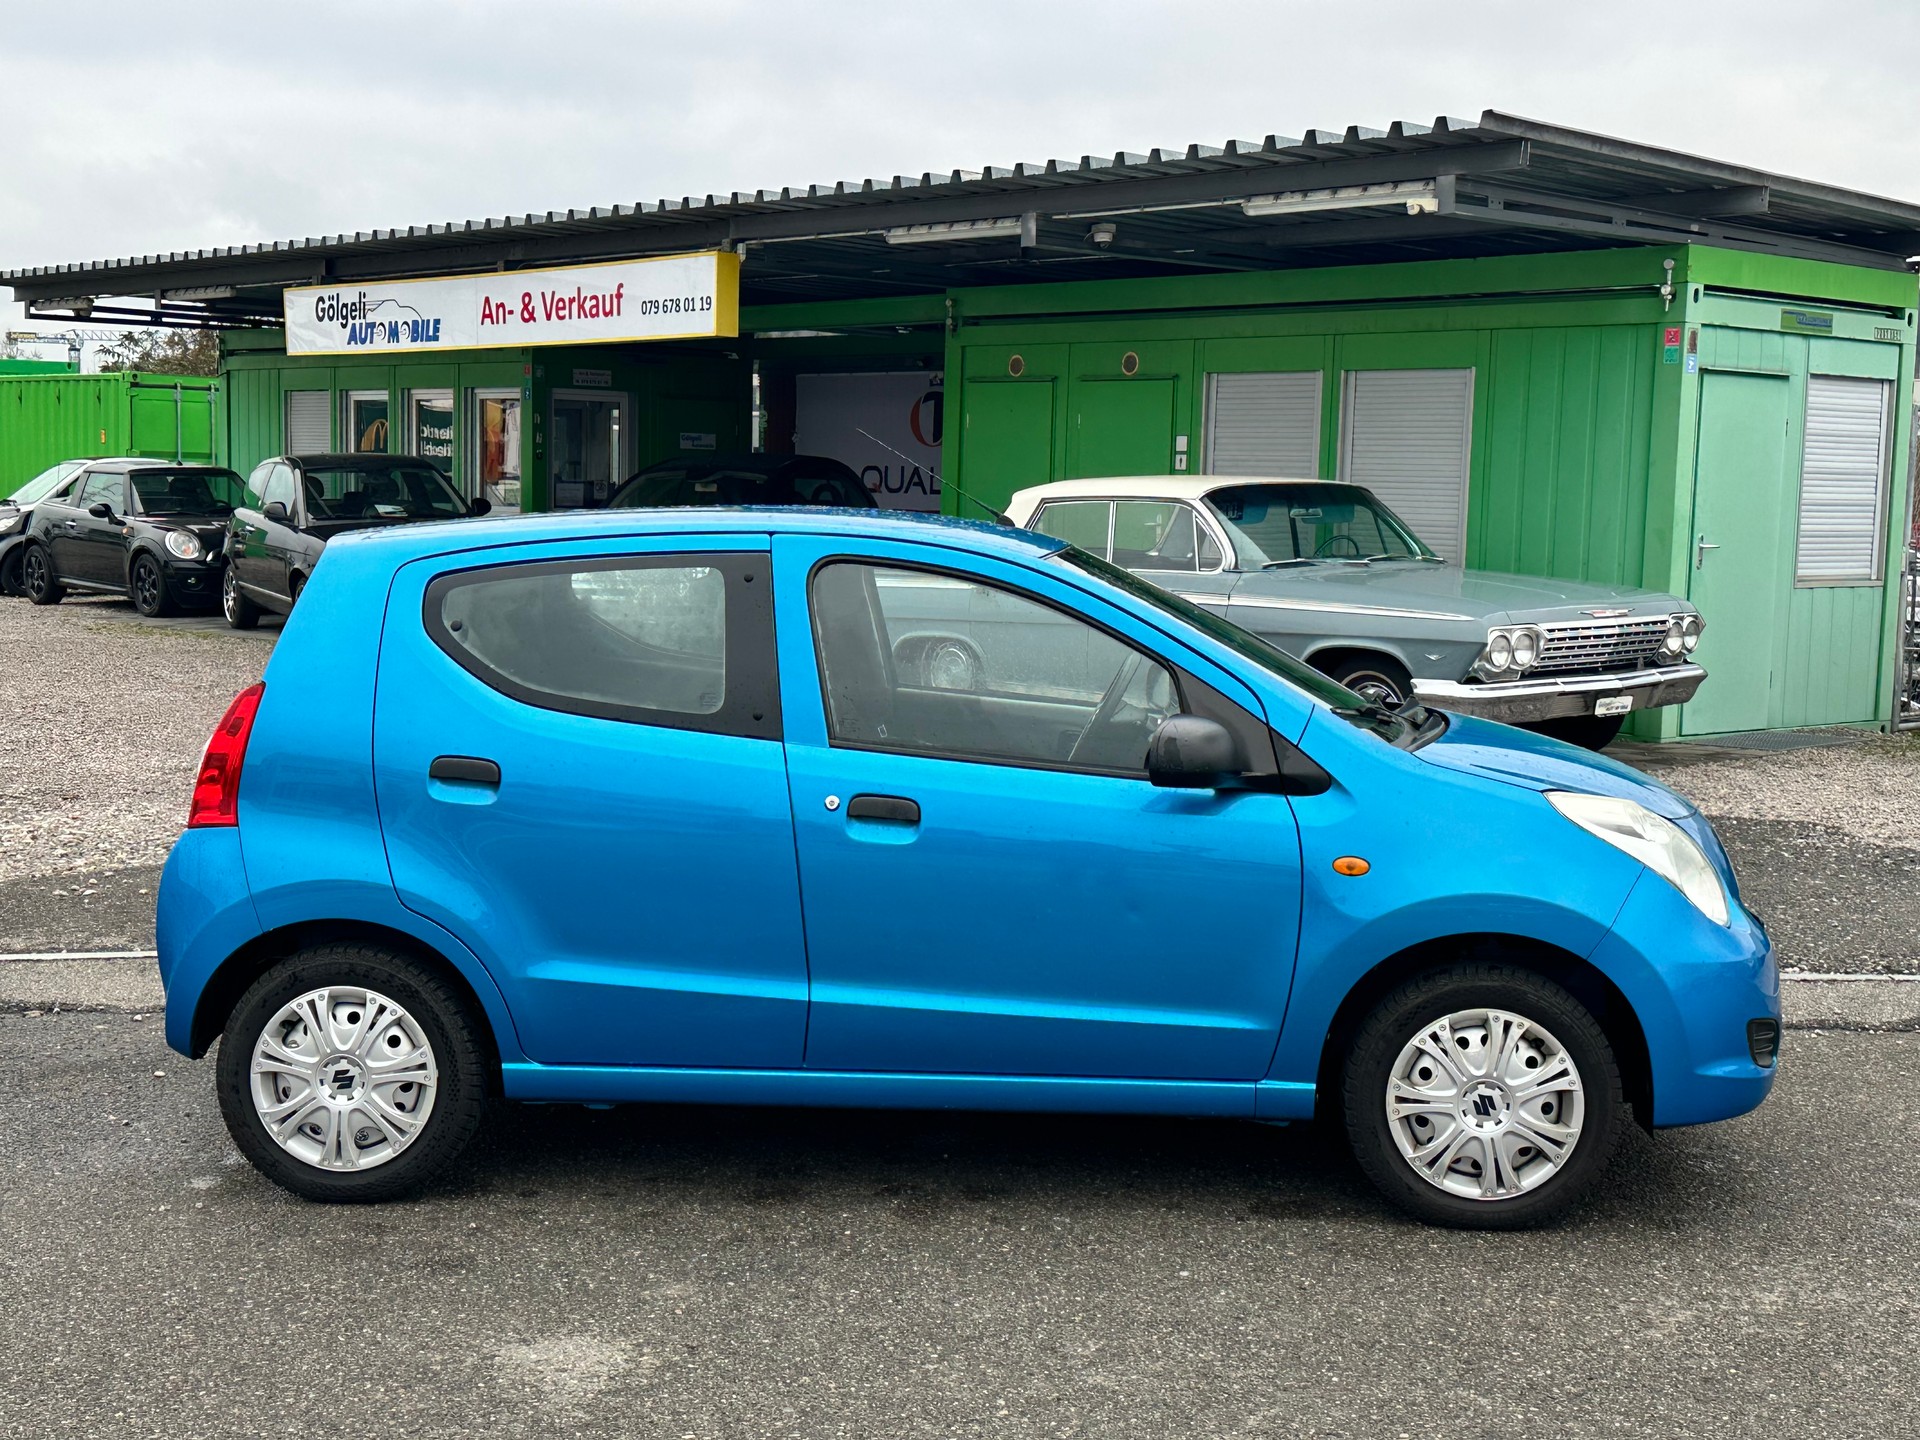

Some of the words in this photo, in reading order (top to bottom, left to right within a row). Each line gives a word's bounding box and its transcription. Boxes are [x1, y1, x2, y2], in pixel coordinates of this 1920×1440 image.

[315, 291, 367, 329] Gölgeli
[480, 295, 515, 326] An-
[520, 291, 537, 324] &
[540, 282, 624, 321] Verkauf
[641, 299, 660, 316] 079
[662, 297, 681, 314] 678
[683, 296, 697, 313] 01
[699, 295, 712, 312] 19
